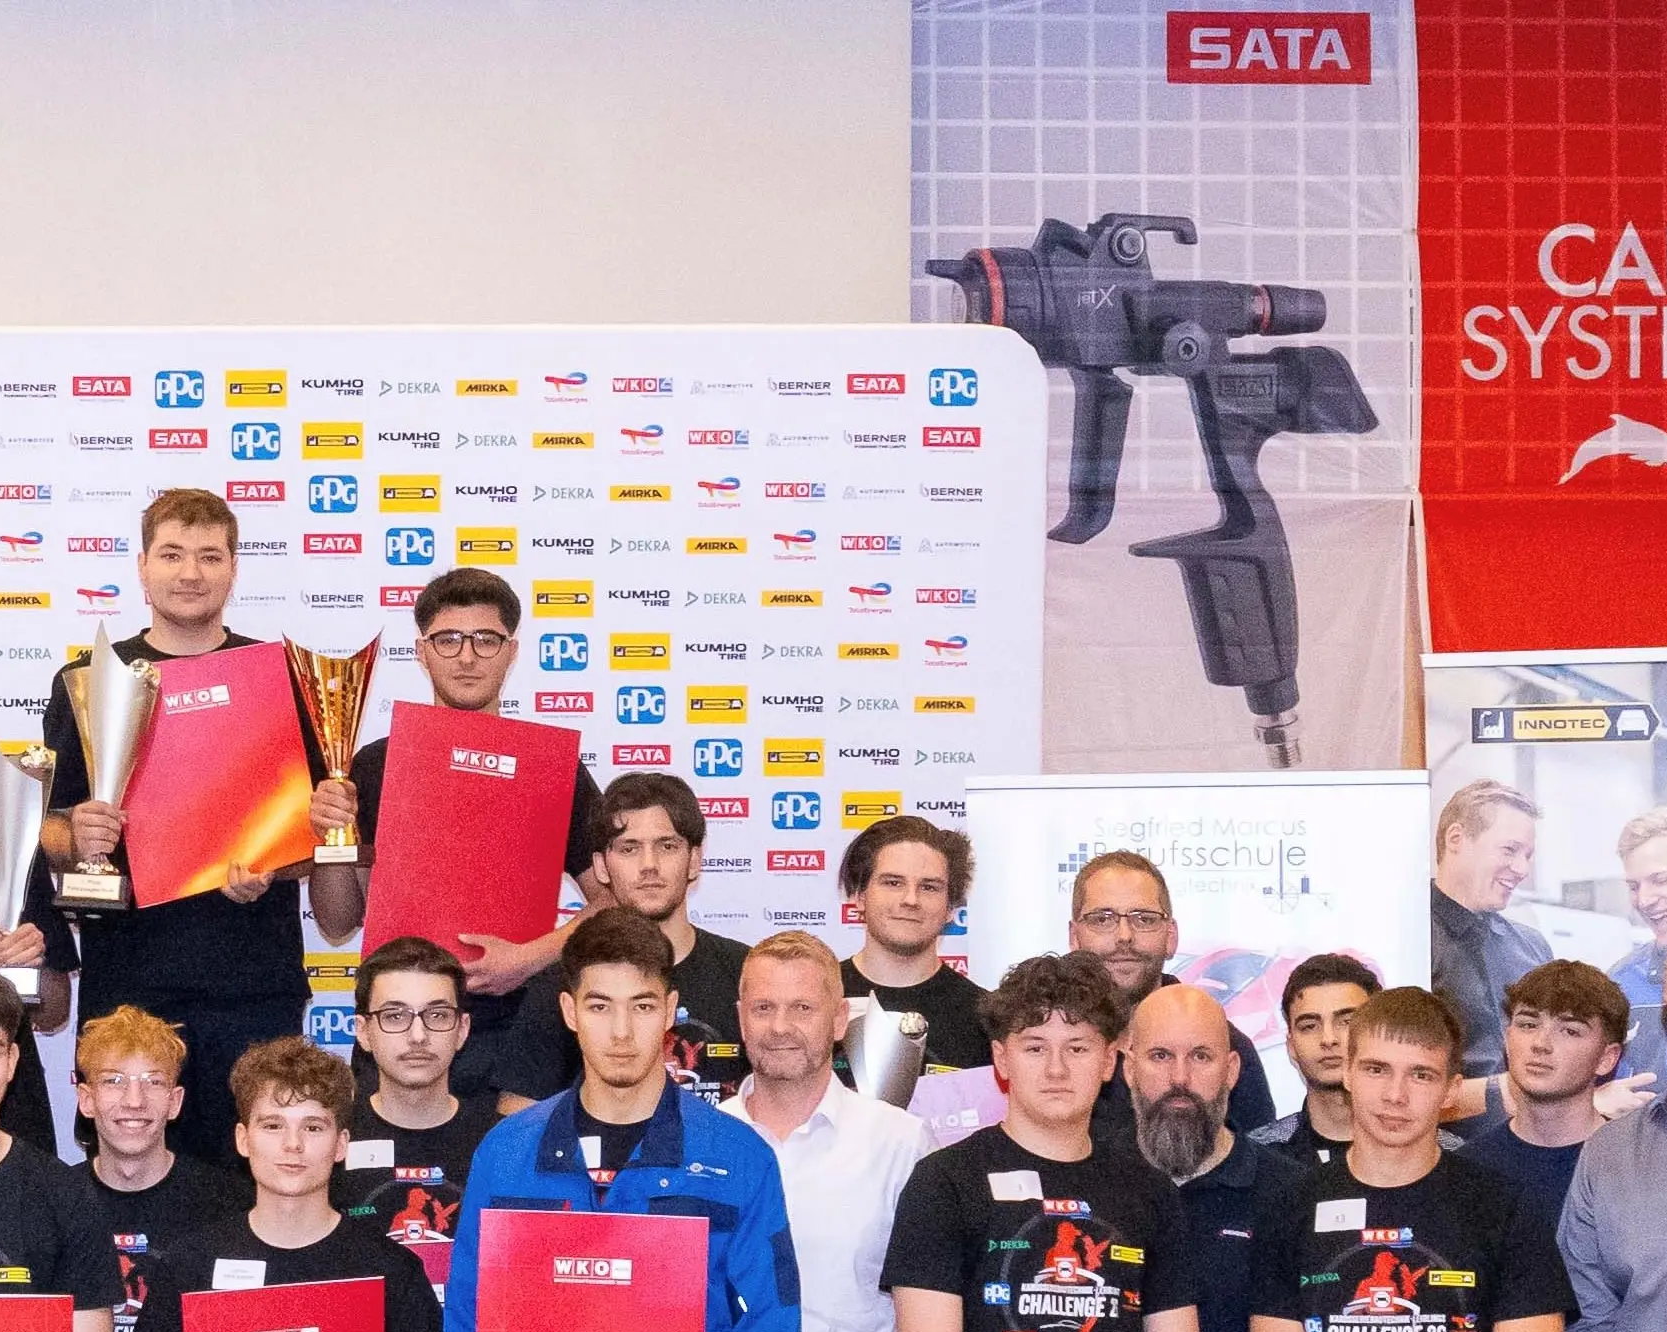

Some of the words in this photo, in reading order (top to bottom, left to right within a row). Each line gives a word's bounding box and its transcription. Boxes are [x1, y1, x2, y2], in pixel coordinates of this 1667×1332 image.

[1189, 27, 1352, 71] SATA
[79, 380, 125, 392] SATA
[158, 374, 200, 404] PPG
[302, 379, 363, 388] KUMHO
[398, 383, 440, 393] DEKRA
[853, 378, 899, 390] SATA
[932, 372, 974, 402] PPG
[379, 432, 439, 441] KUMHO
[475, 435, 516, 446] DEKRA
[232, 485, 279, 498] SATA
[312, 479, 354, 509] PPG
[310, 538, 356, 550] SATA
[389, 531, 431, 561] PPG
[533, 539, 594, 547] KUMHO
[628, 540, 670, 551] DEKRA
[543, 637, 584, 667] PPG
[686, 644, 746, 652] KUMHO
[781, 646, 822, 657] DEKRA
[165, 687, 211, 709] WKO
[541, 696, 588, 708] SATA
[924, 701, 966, 709] MIRKA
[1517, 718, 1606, 731] INNOTEC
[452, 749, 499, 769] WKO
[618, 749, 665, 761] SATA
[697, 742, 740, 773] PPG
[873, 756, 898, 765] TIRE
[933, 752, 975, 763] DEKRA
[1094, 817, 1203, 842] Siegfried
[1213, 818, 1307, 838] Marcus
[773, 854, 819, 867] SATA
[1093, 841, 1307, 868] Bufsschule
[395, 1167, 427, 1179] WKO
[1044, 1199, 1077, 1212] WKO
[1360, 1229, 1399, 1242] WKO
[999, 1239, 1031, 1249] DEKRA
[554, 1258, 610, 1277] WKO
[984, 1284, 1011, 1303] PPG
[1017, 1293, 1106, 1318] CHALLENGE
[1108, 1297, 1120, 1318] 2
